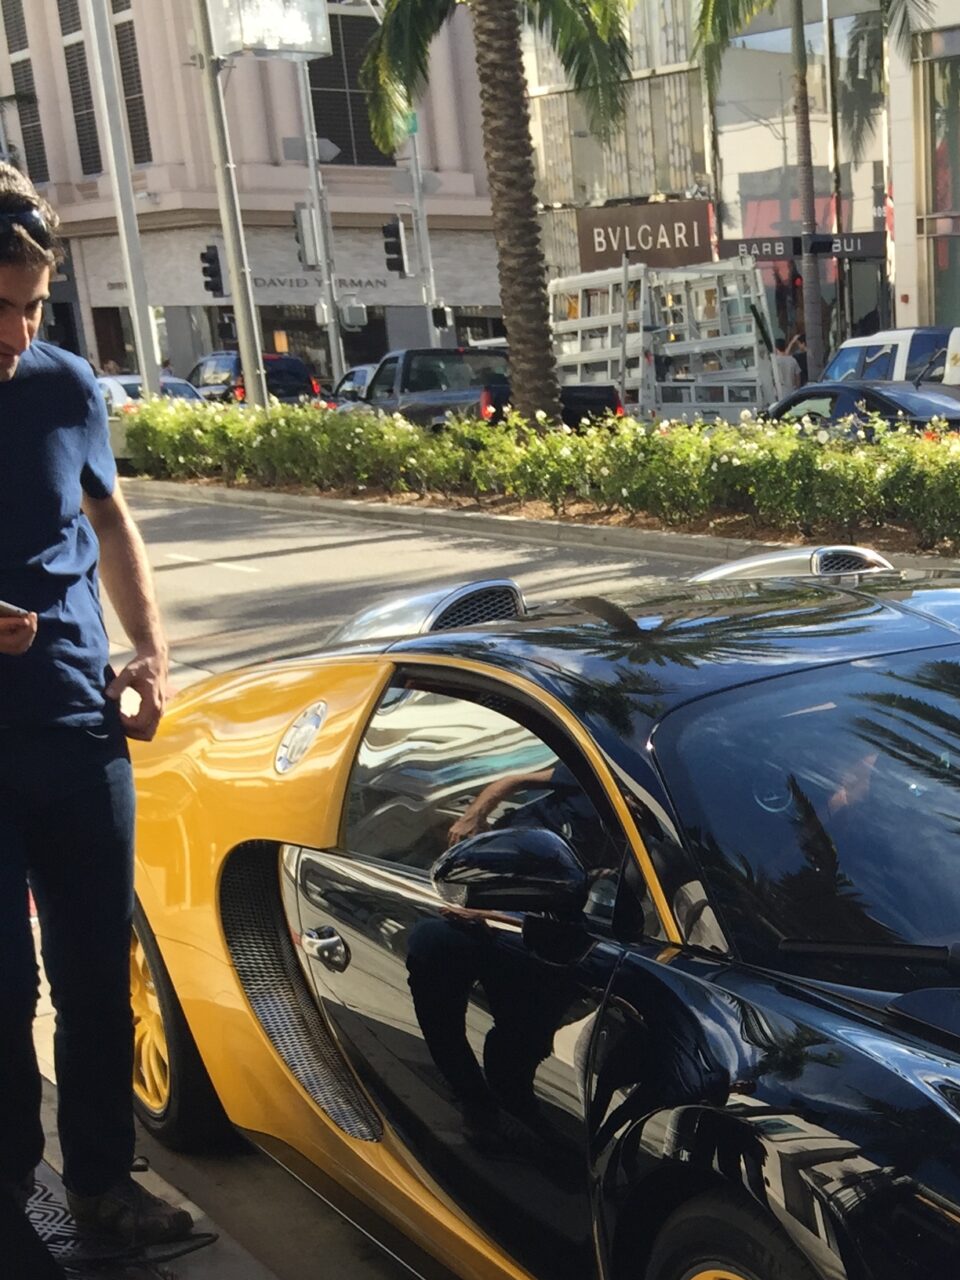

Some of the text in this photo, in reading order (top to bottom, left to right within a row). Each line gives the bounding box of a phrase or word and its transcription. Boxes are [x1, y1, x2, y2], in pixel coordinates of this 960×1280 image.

[593, 221, 700, 253] BVLGARI
[832, 238, 861, 252] BUI
[253, 278, 387, 289] DAVID YRMAN
